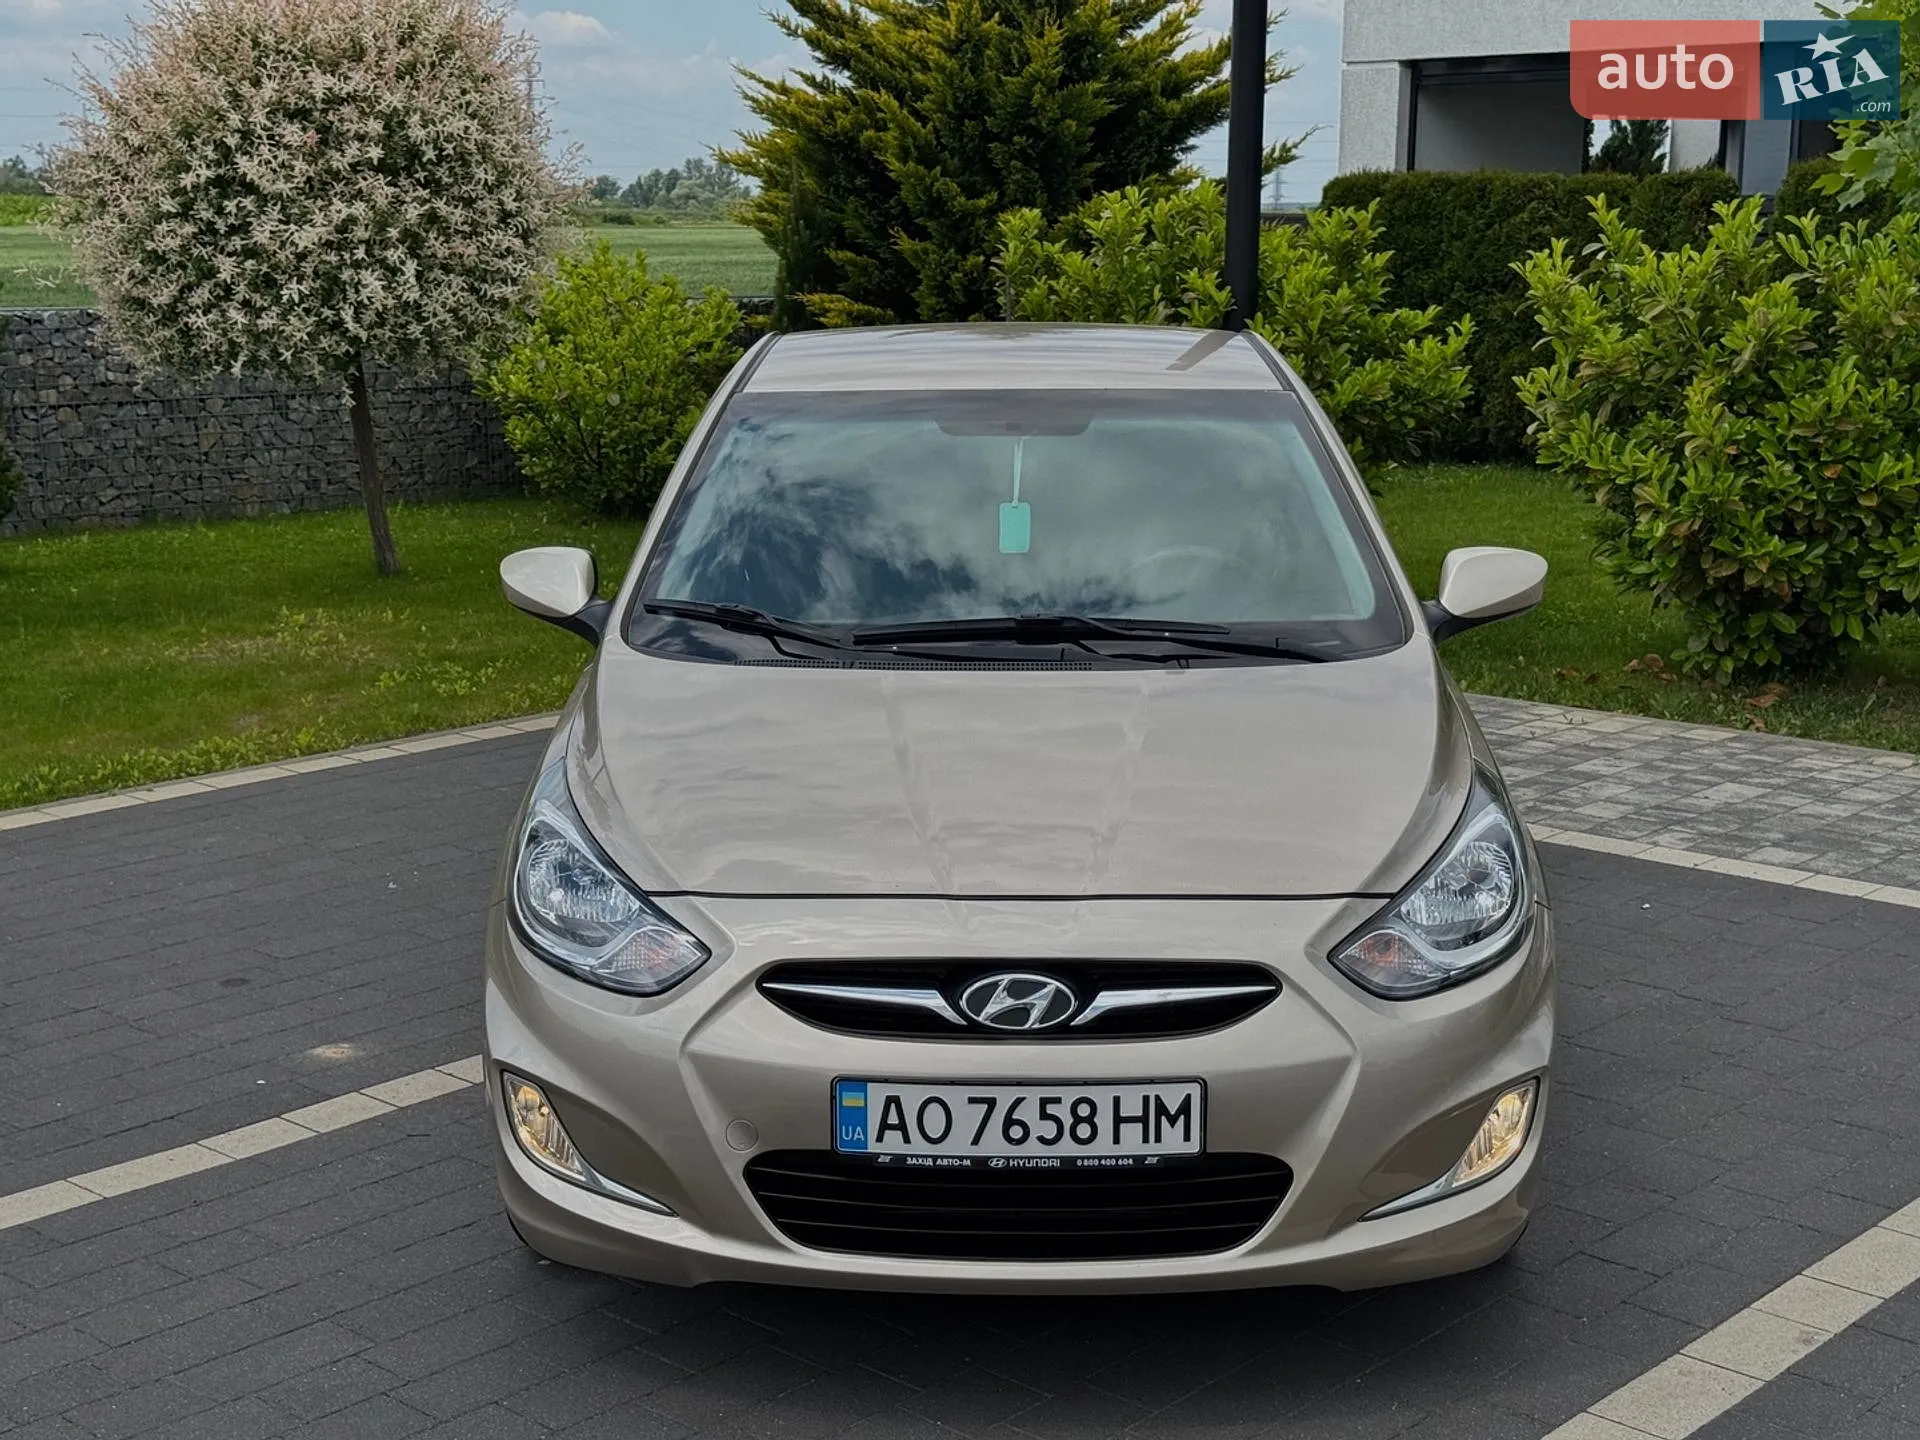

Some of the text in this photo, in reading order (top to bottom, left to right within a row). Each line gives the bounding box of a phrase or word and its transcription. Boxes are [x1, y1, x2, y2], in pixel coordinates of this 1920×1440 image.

[967, 1096, 1099, 1146] 7658
[1112, 1092, 1193, 1145] HM
[842, 1127, 865, 1142] UA
[906, 1156, 971, 1167] ЗАХІД АВТО-М
[1009, 1158, 1061, 1168] HYUNDAI
